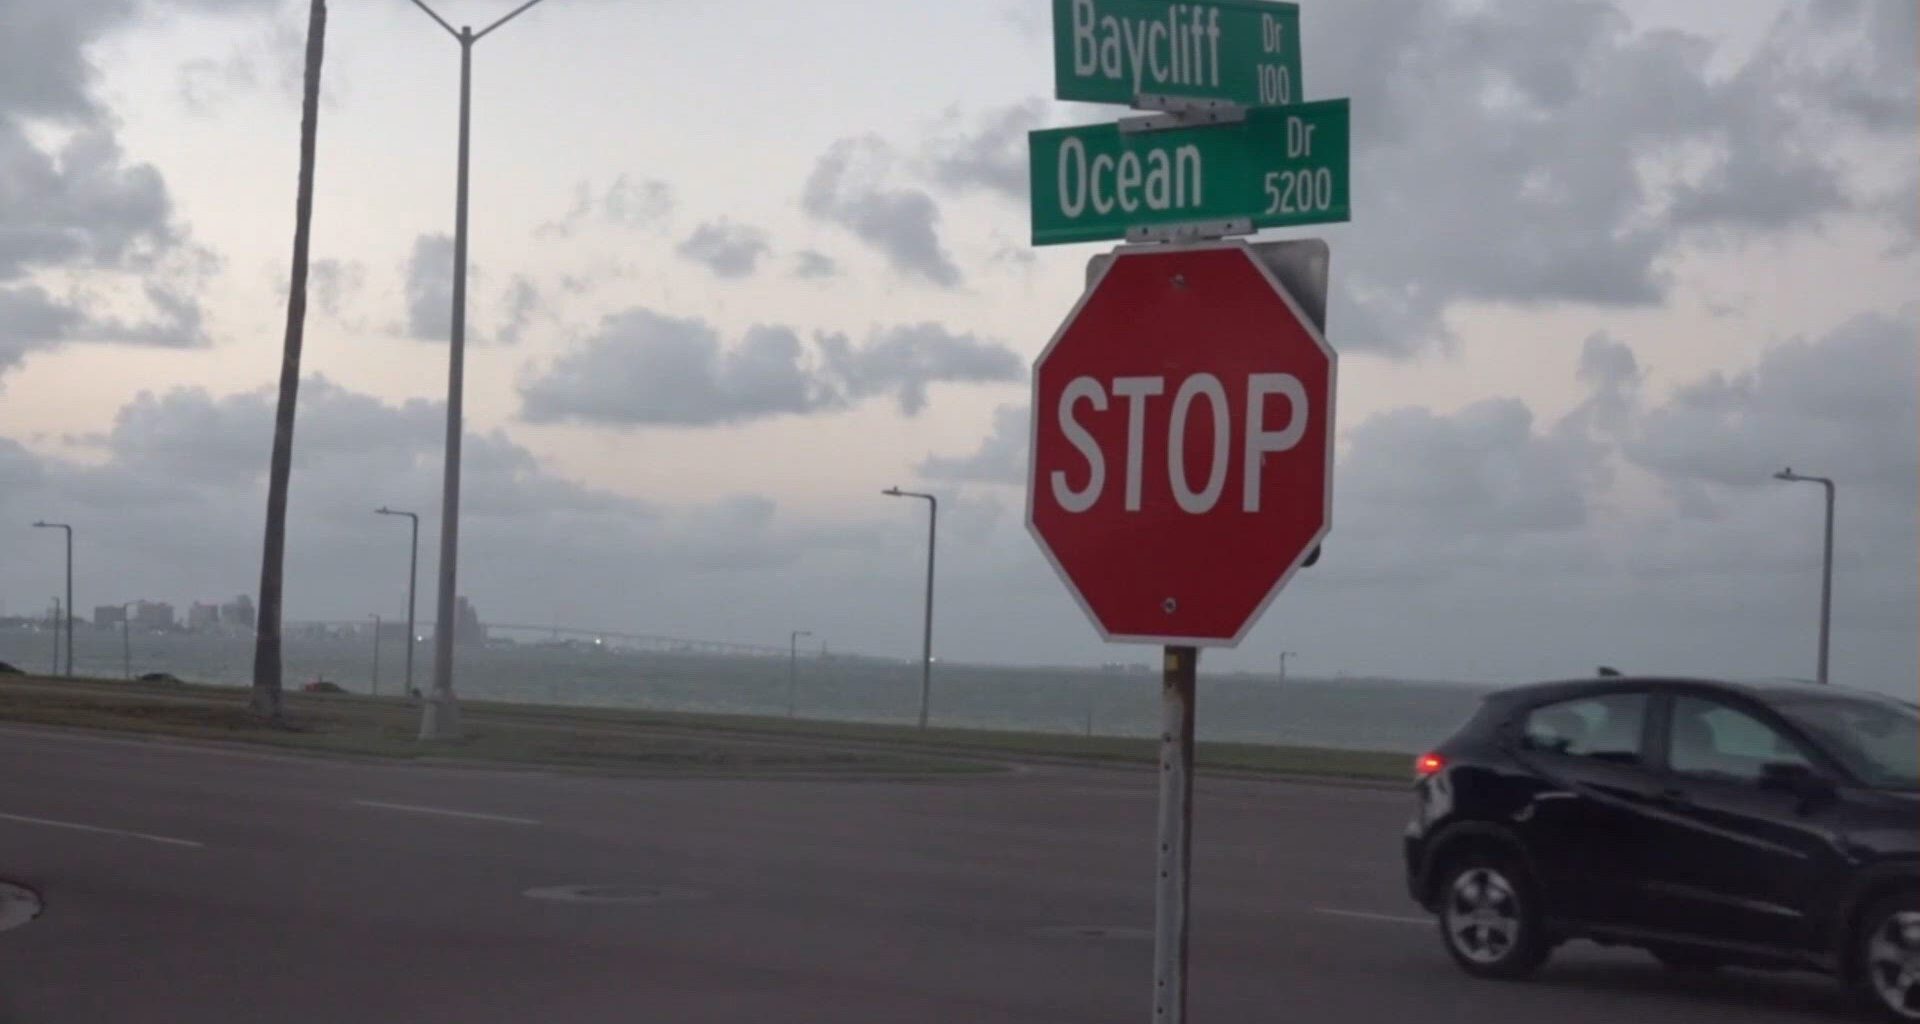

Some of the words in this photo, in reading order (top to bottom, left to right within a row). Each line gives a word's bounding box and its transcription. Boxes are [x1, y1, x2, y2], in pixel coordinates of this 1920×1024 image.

[1072, 0, 1221, 95] Baycliff
[1262, 13, 1283, 54] Dr
[1257, 64, 1290, 105] 100
[1057, 136, 1203, 219] Ocean
[1287, 116, 1316, 158] Dr
[1264, 167, 1332, 215] 5200
[1050, 372, 1310, 515] STOP
